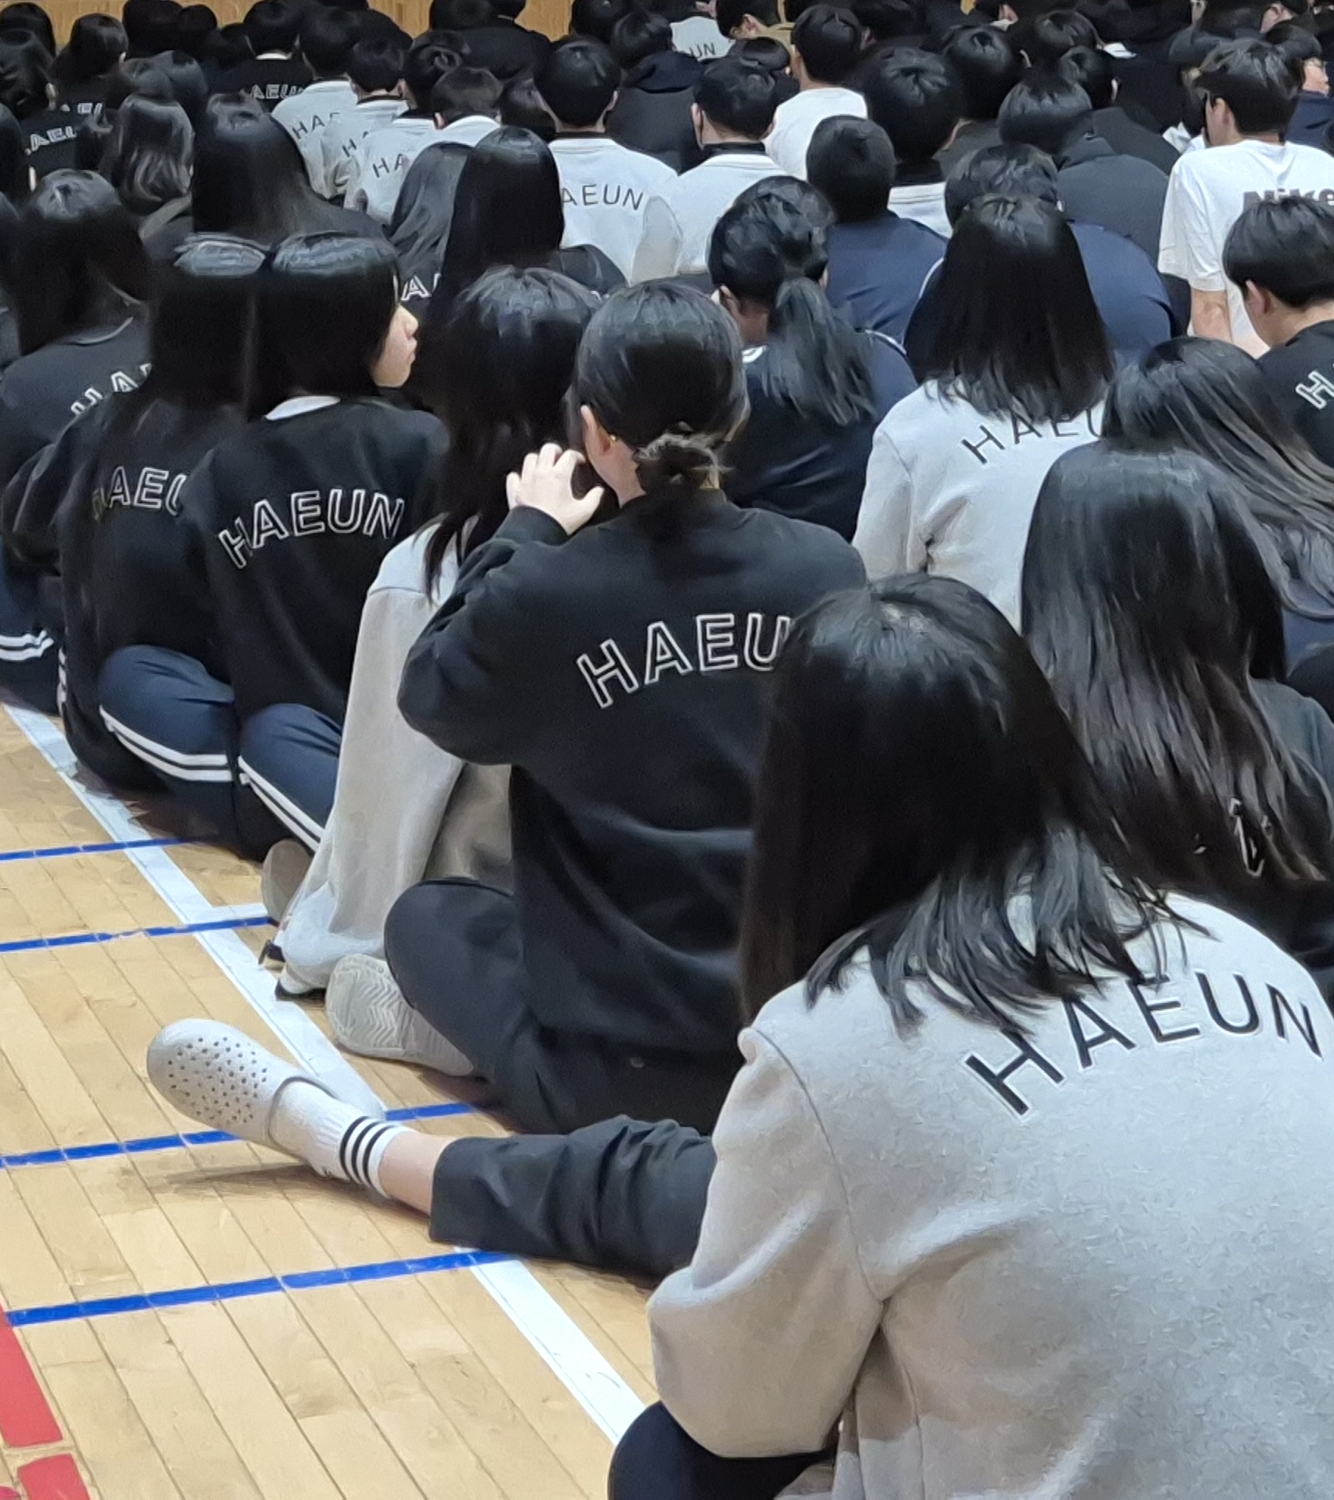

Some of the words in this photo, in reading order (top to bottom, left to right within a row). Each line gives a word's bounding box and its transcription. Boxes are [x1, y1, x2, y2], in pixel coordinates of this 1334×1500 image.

[561, 183, 644, 211] AEUN
[217, 488, 405, 570] HAEUN
[575, 612, 792, 710] HAEU
[965, 969, 1324, 1118] HAEUN
